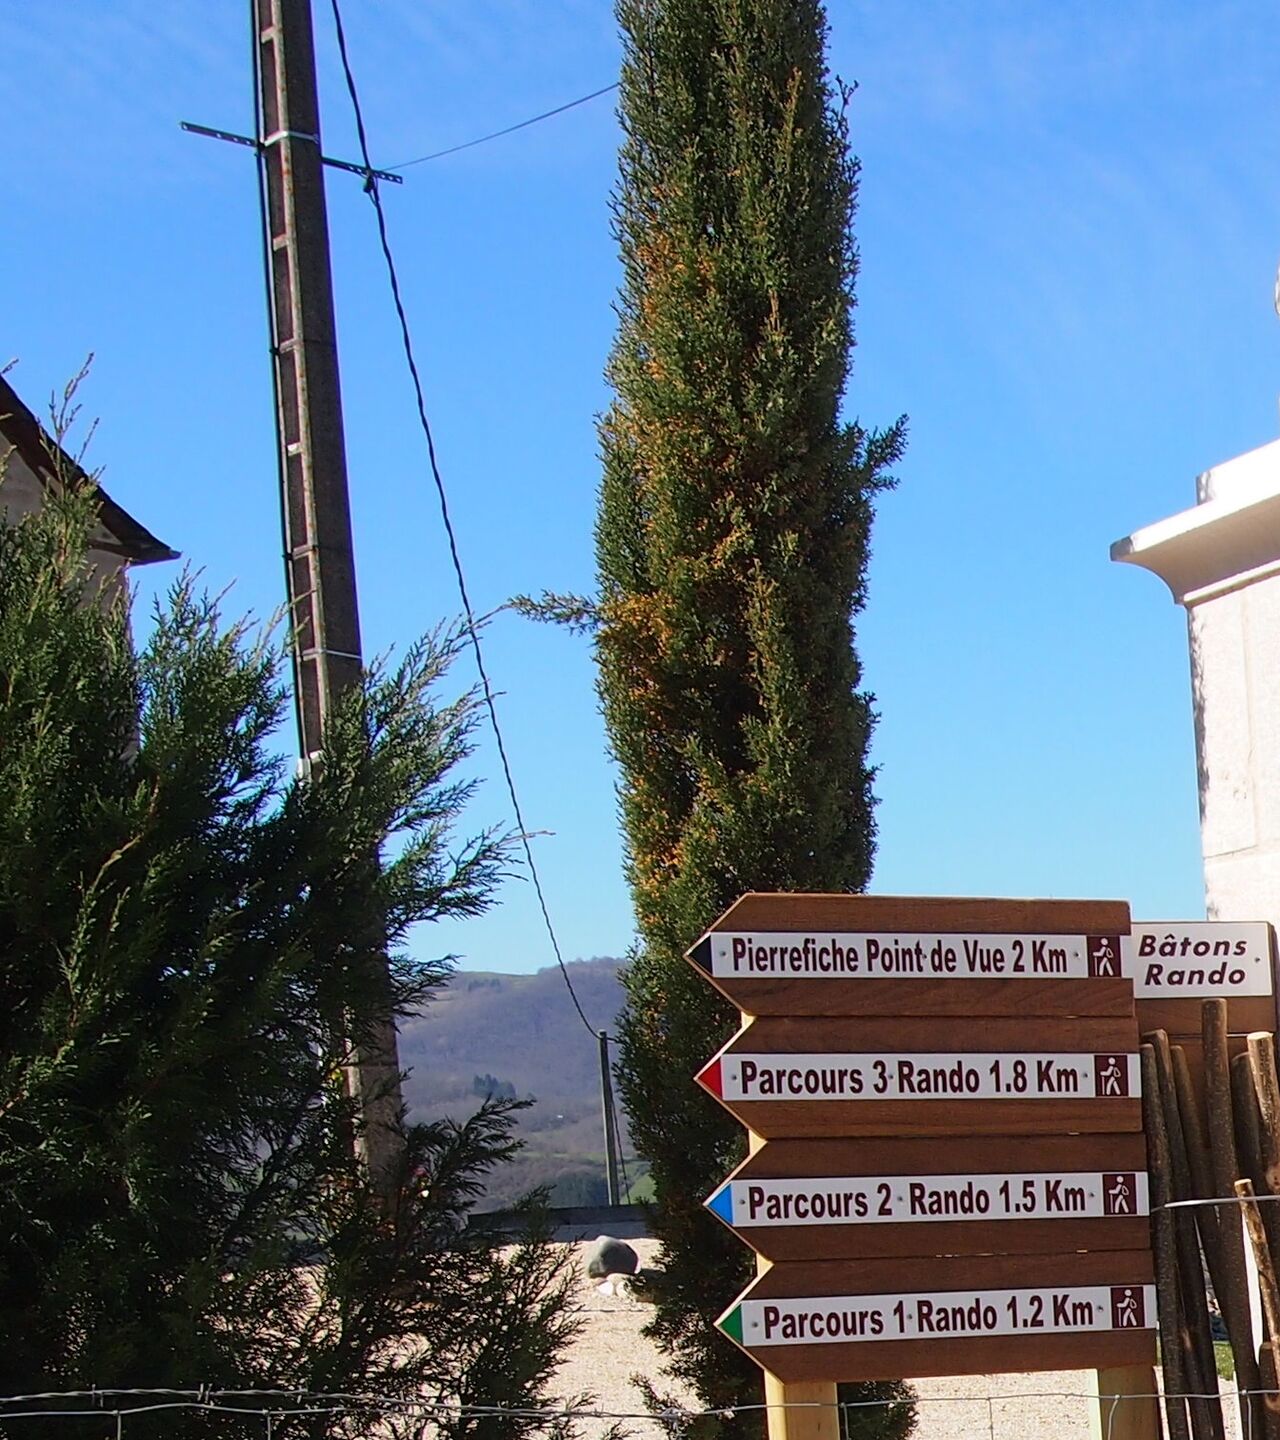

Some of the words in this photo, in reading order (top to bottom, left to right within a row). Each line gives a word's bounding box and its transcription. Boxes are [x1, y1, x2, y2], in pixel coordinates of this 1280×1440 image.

[732, 938, 859, 972] Pierrefiche
[867, 938, 923, 973] Point
[930, 939, 956, 973] de
[963, 939, 1005, 973] Vue
[1011, 940, 1025, 973] 2
[1032, 940, 1067, 973] Km
[1138, 933, 1248, 957] Bâtons
[1144, 964, 1246, 986] Rando
[740, 1060, 863, 1094] Parcours
[872, 1060, 888, 1094] 3
[898, 1060, 980, 1094] Rando
[989, 1060, 1027, 1093] 1.8
[1037, 1060, 1078, 1093] Km
[748, 1185, 869, 1220] Parcours
[877, 1183, 893, 1216] 2
[909, 1181, 990, 1215] Rando
[999, 1180, 1035, 1213] 1.5
[1045, 1179, 1086, 1212] Km
[763, 1305, 884, 1339] Parcours
[893, 1300, 906, 1333] 1
[917, 1298, 998, 1333] Rando
[1006, 1295, 1044, 1329] 1.2
[1053, 1294, 1094, 1327] Km
